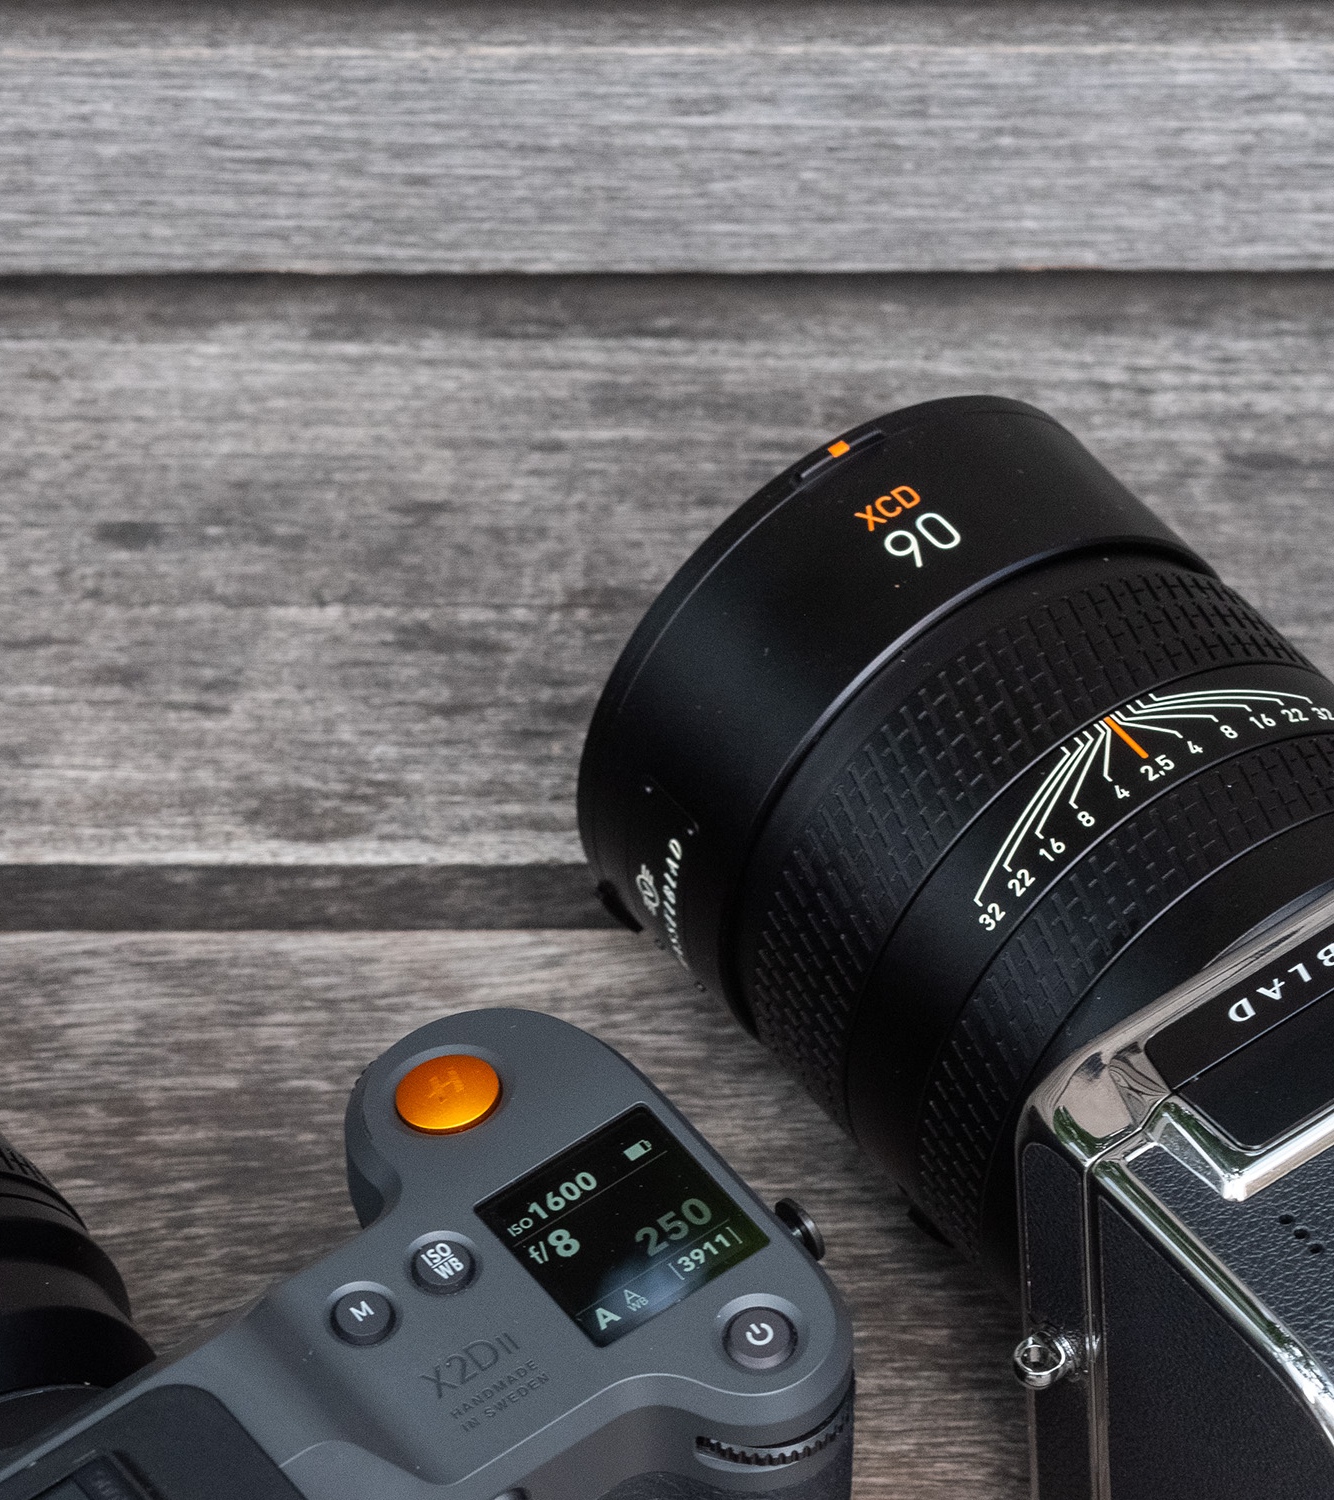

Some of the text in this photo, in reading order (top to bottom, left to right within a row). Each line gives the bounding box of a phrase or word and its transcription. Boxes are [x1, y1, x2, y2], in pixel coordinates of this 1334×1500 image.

[853, 483, 922, 533] XCD
[882, 510, 961, 568] 90
[978, 903, 1006, 931] 32
[1008, 868, 1036, 897] 22
[1038, 838, 1066, 862] 16
[1077, 810, 1095, 828] 8
[1114, 784, 1130, 799] 4
[1187, 740, 1203, 755] 4
[1220, 725, 1239, 740] 8
[1249, 713, 1276, 729] 16
[1280, 708, 1309, 723] 22
[507, 1171, 597, 1237] ISO 1600
[635, 1198, 712, 1257] 250
[420, 1243, 452, 1267] ISO
[433, 1257, 465, 1279] WB
[349, 1300, 375, 1322] M
[595, 1307, 621, 1331] A
[450, 1359, 538, 1419] HANDMADE
[461, 1372, 550, 1432] IN SWEDEN
